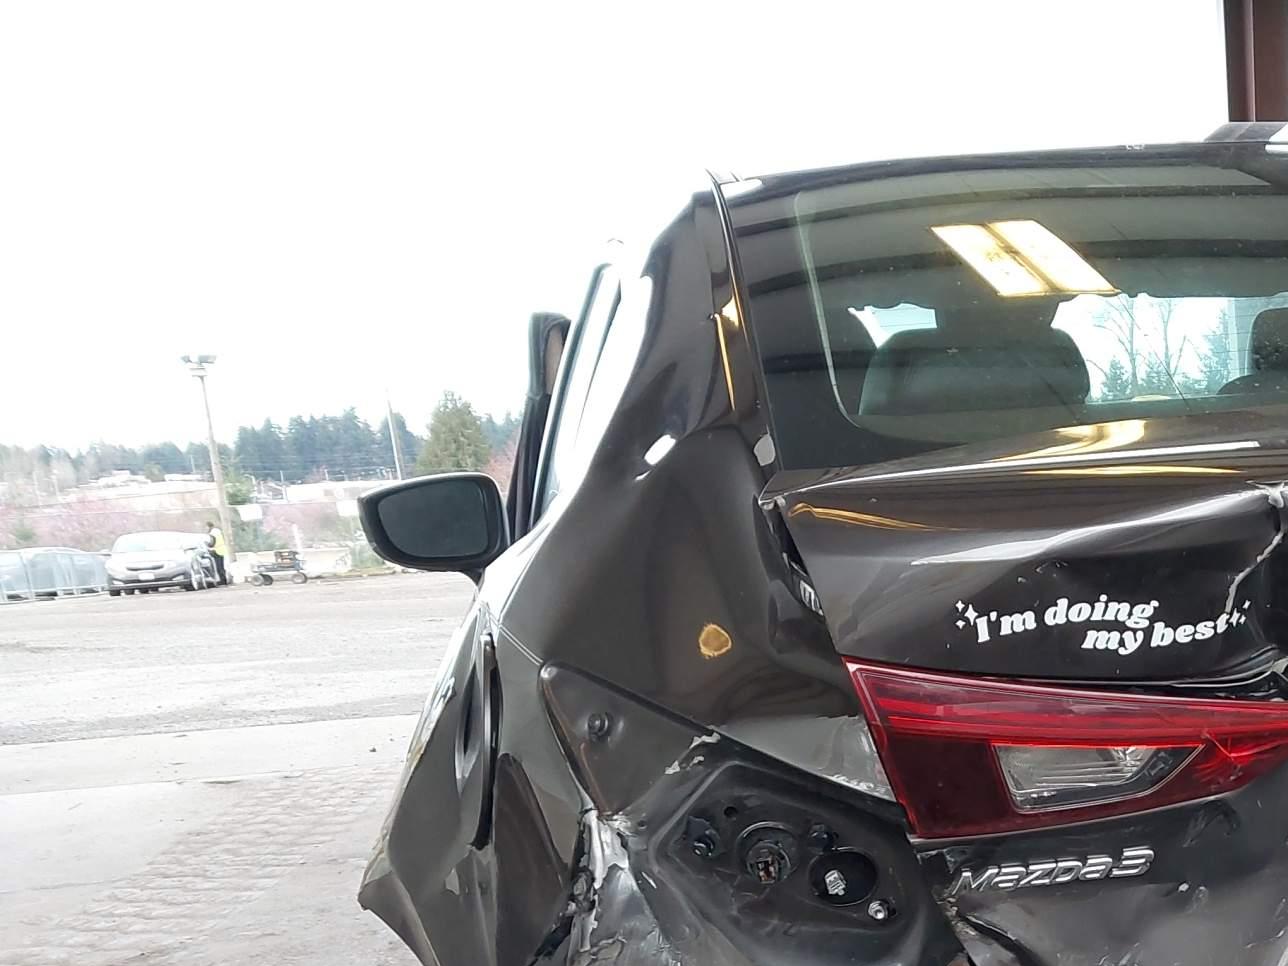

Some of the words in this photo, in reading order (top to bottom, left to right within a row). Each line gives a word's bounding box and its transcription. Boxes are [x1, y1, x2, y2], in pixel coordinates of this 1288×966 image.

[976, 611, 1036, 642] I'm
[1044, 594, 1159, 628] doing
[1081, 628, 1144, 655] my
[1150, 612, 1230, 647] best
